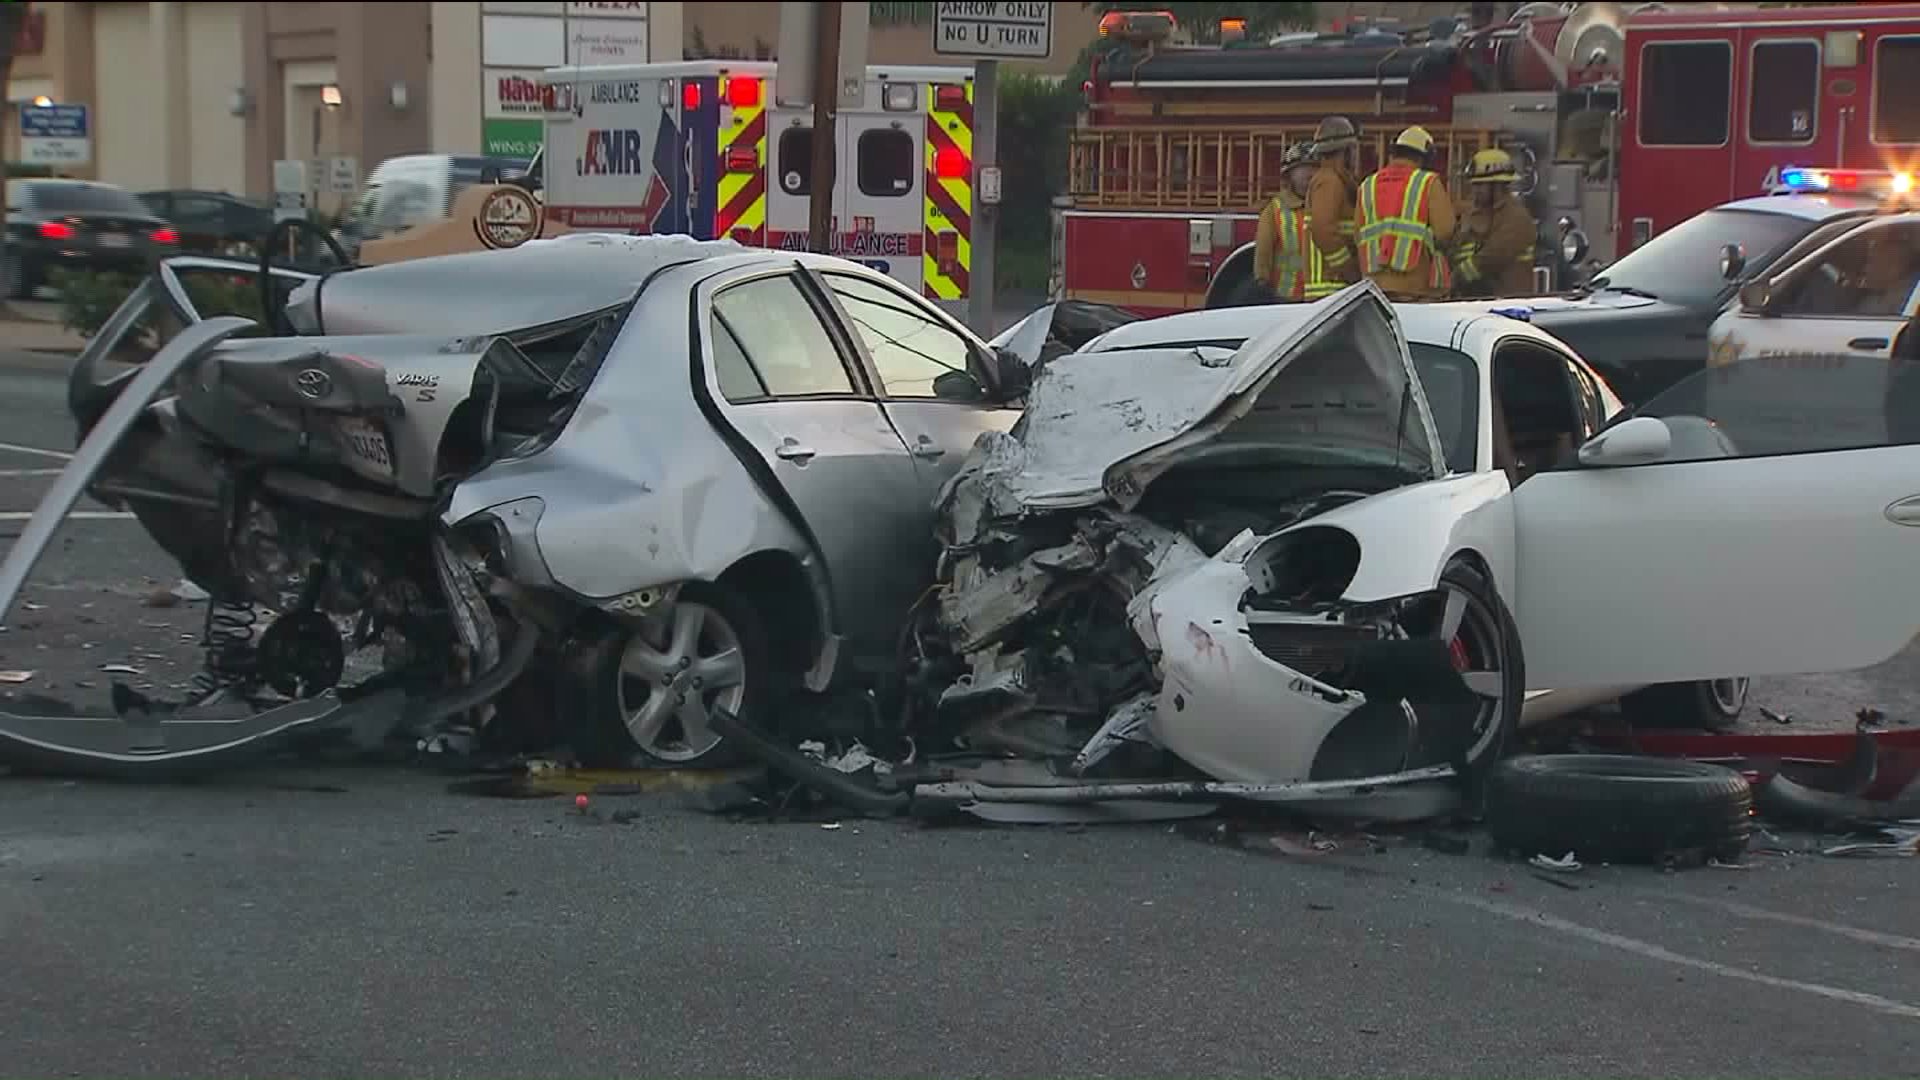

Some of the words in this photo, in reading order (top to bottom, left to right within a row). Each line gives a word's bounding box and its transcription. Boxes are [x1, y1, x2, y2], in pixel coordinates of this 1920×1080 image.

[941, 2, 996, 15] ARROW
[1006, 2, 1045, 18] ONLY
[945, 25, 967, 41] NO
[976, 24, 989, 44] U
[997, 28, 1039, 45] TURN
[590, 81, 639, 103] AMBULANCE
[489, 138, 525, 154] WING
[584, 129, 641, 175] AMR
[780, 232, 909, 255] AMULANCE
[396, 373, 440, 388] YARIS
[415, 389, 437, 402] S
